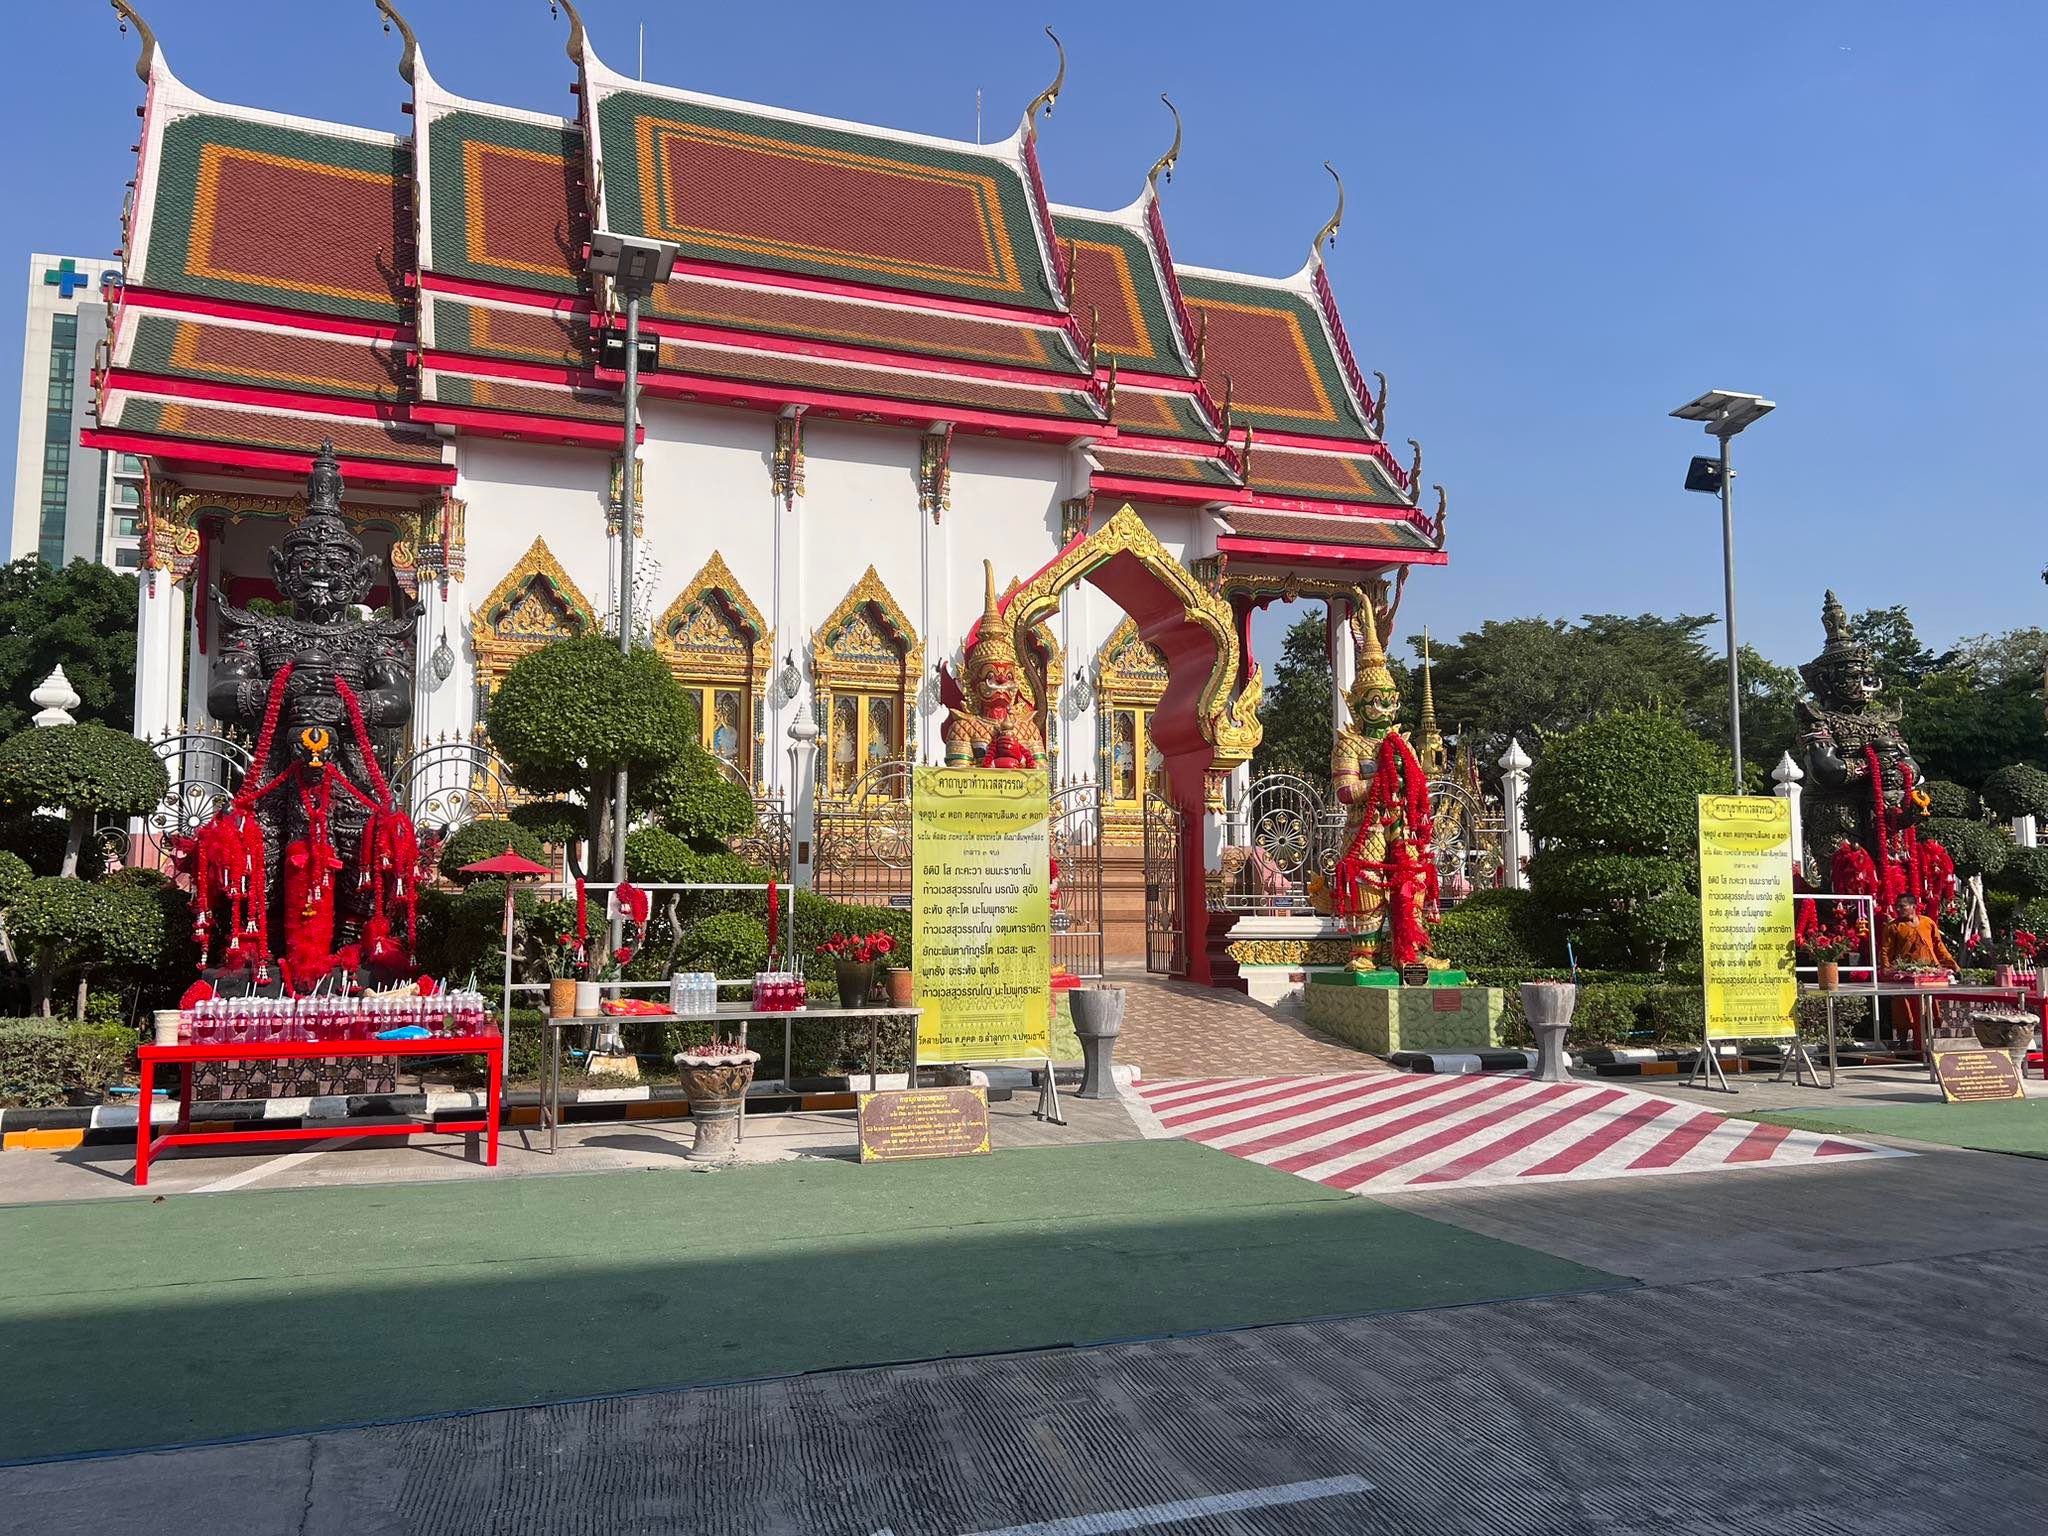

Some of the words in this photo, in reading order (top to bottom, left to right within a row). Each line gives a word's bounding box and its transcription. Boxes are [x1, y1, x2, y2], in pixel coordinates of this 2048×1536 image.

[939, 774, 1024, 795] คาถาบูชาท้าวเวสสุวรรณ
[948, 811, 962, 819] ดอก
[1029, 812, 1044, 820] ดอก
[923, 865, 940, 875] อิติปิ
[943, 863, 952, 875] โส
[954, 867, 982, 875] ภะคะวา
[985, 863, 1031, 875] ยมมะราชาโน
[923, 881, 992, 897] ท้าวเวสสุวรรณโณ
[995, 884, 1019, 894] มรณัง
[1022, 884, 1039, 897] สุขัง
[923, 904, 943, 915] อะหัง
[946, 902, 969, 917] สุคะโต
[923, 921, 992, 936] ท้าวเวสสุวรรณโณ
[996, 945, 1018, 955] เวสสะ
[1021, 945, 1037, 957] พุสะ
[948, 965, 976, 976] อะระหัง
[922, 983, 992, 999] ท้าวเวสสุวรรณโณ
